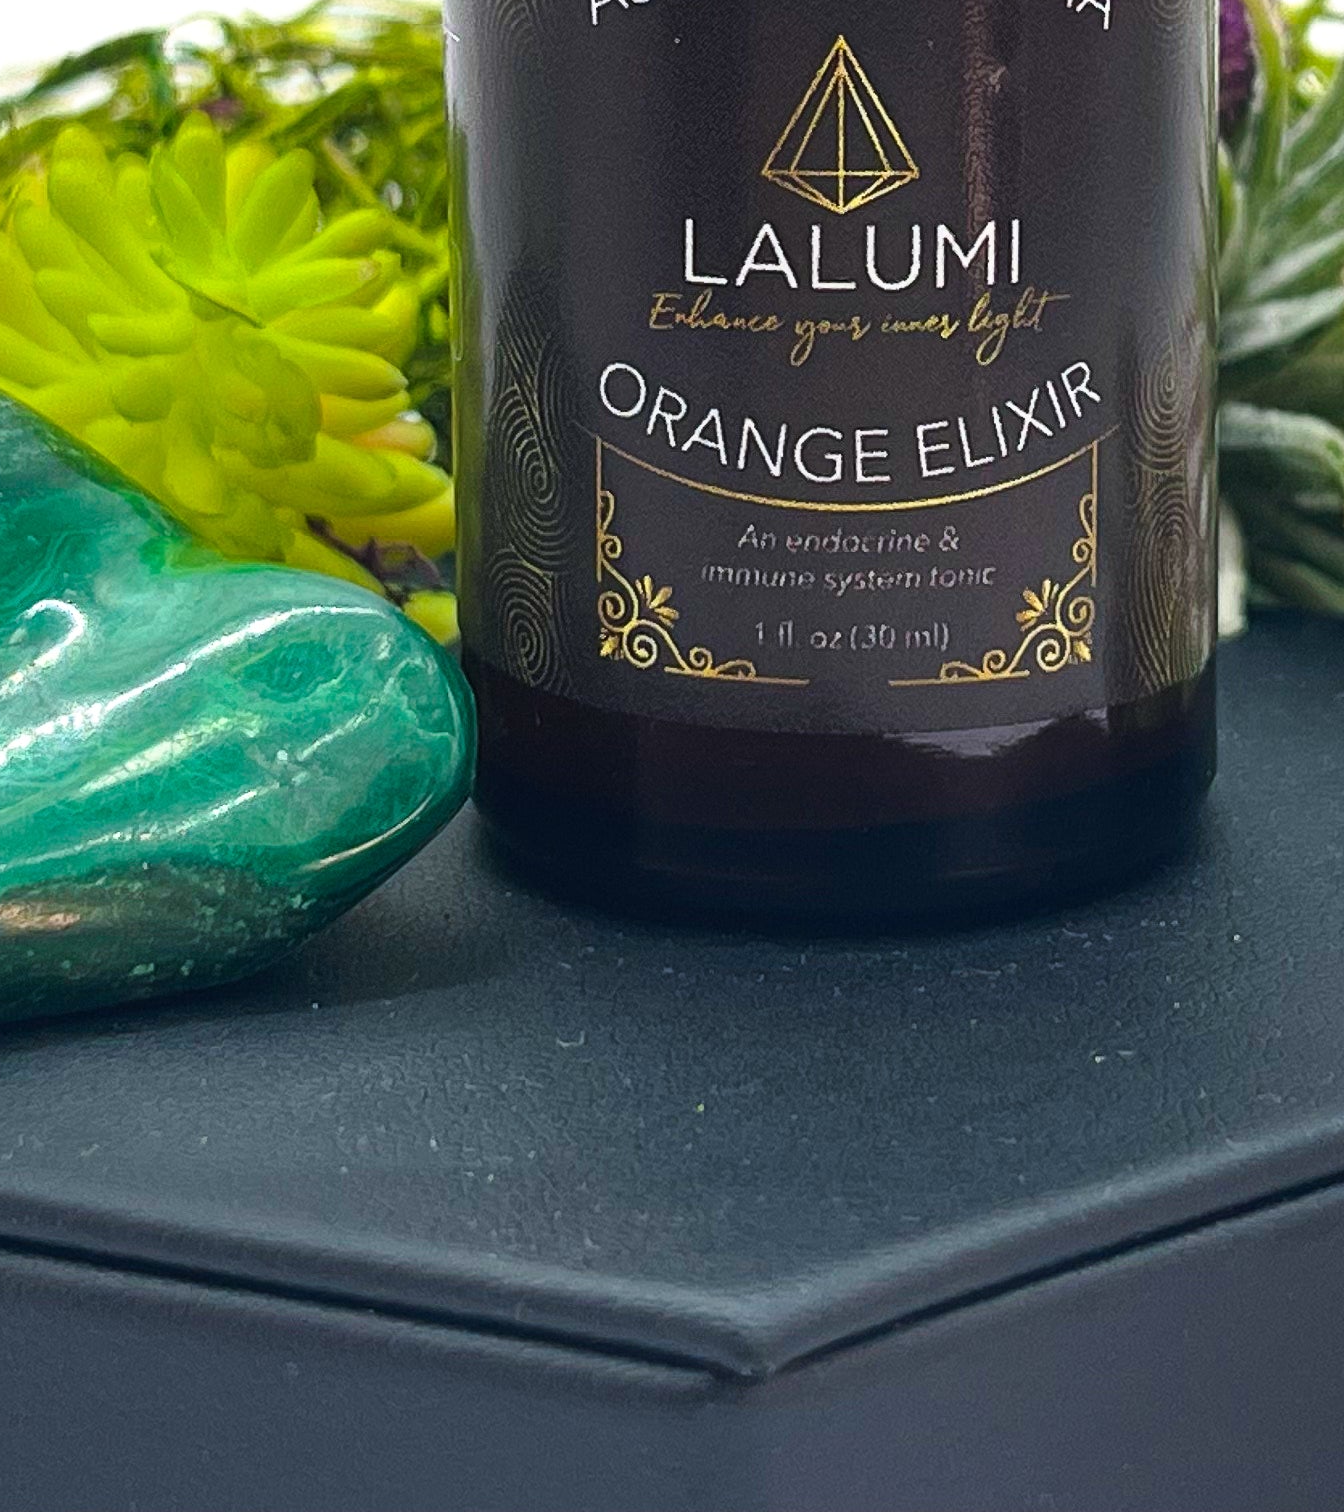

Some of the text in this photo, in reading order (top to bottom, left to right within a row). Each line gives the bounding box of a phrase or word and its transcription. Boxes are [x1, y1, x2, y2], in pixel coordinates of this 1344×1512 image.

[684, 218, 1021, 291] LALUMI
[648, 287, 1071, 367] Enhance your inner light
[599, 360, 1102, 482] ORANGE ELIXIR
[737, 524, 960, 553] An endocrine &
[702, 564, 997, 597] immune system tonic
[756, 621, 765, 645] 1
[810, 631, 842, 649] oz
[905, 622, 950, 652] ml)
